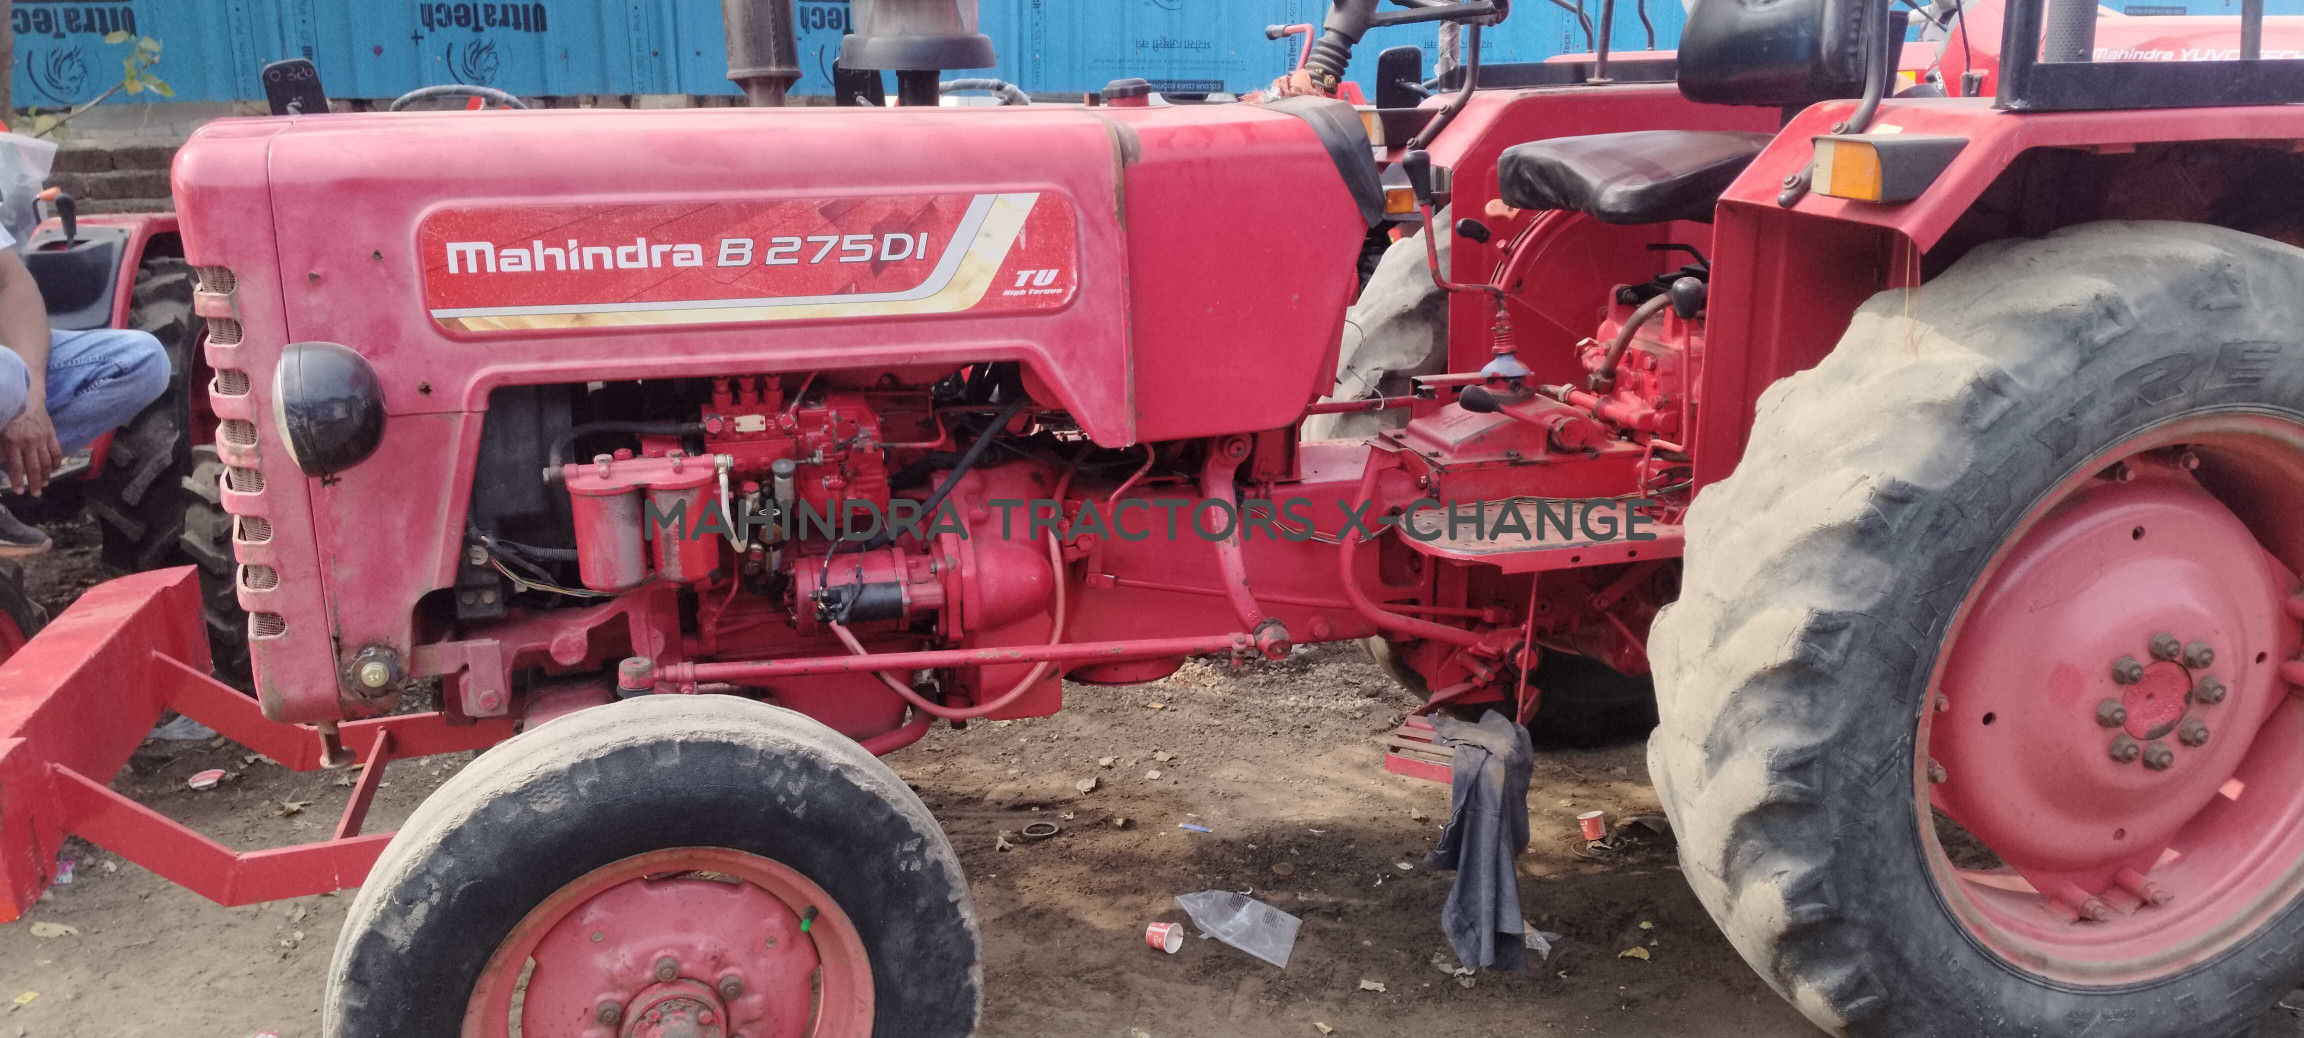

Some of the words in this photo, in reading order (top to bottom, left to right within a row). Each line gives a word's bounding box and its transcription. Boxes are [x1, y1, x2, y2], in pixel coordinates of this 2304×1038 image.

[11, 6, 137, 40] UltraTec
[2094, 47, 2175, 61] Mahindra
[1152, 82, 1177, 90] ROOFIN
[446, 237, 704, 275] Mahindra
[716, 237, 755, 268] B
[1014, 268, 1060, 287] TU
[1002, 289, 1027, 297] High
[1028, 288, 1064, 296] Torque
